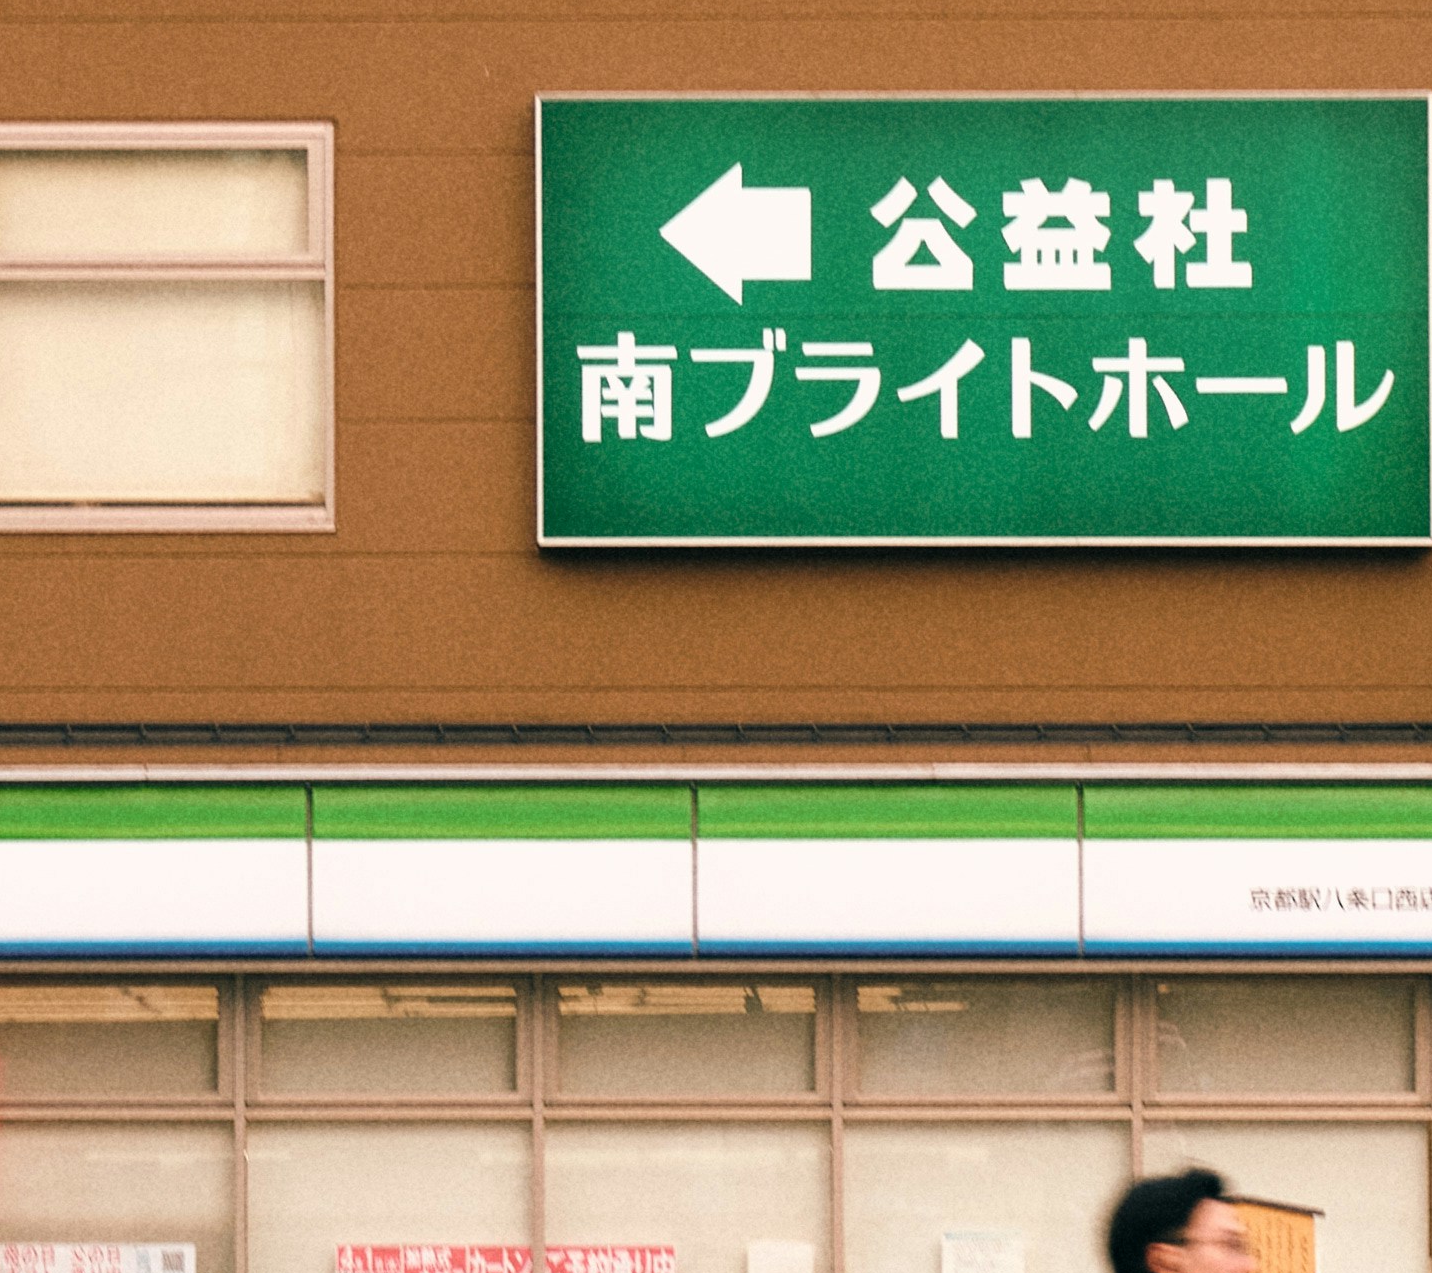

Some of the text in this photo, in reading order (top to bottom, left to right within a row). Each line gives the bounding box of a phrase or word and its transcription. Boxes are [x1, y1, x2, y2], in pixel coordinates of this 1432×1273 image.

[869, 176, 1253, 291] 公益社
[575, 326, 1395, 444] 南ブライトホール
